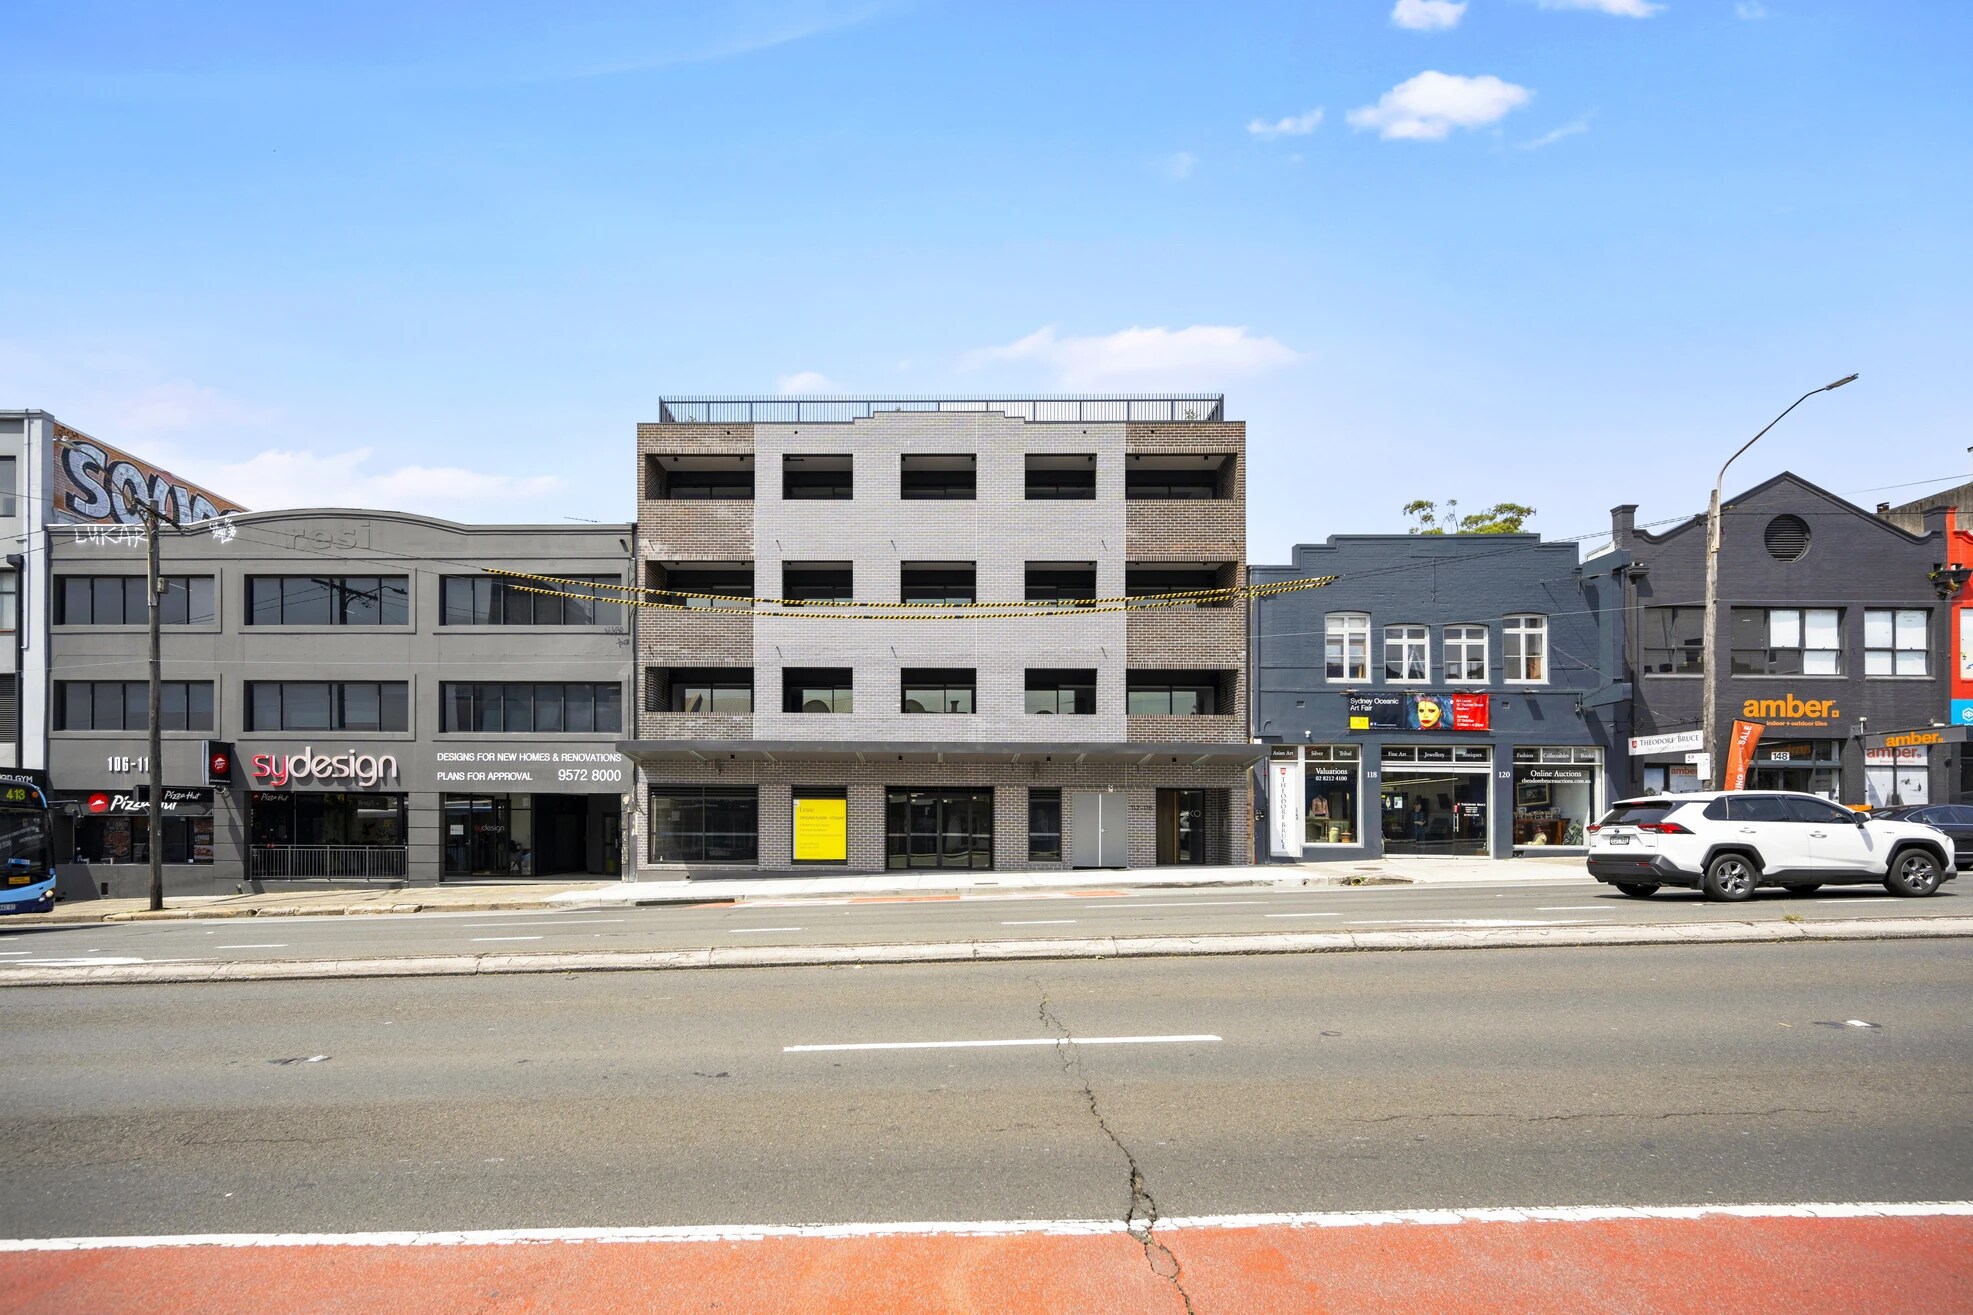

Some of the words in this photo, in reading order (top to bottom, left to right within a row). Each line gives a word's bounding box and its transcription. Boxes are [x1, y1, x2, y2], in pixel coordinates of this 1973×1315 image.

[1350, 697, 1373, 705] Sydney
[1374, 697, 1400, 705] Oceanic
[1738, 725, 1752, 745] SALE
[437, 753, 475, 761] DESIGNS
[477, 753, 496, 761] FOR
[497, 753, 517, 761] NEW
[519, 753, 551, 761] HOMES
[553, 753, 560, 762] &
[561, 753, 621, 762] RENOVATIONS
[252, 746, 397, 787] sydesign
[15, 775, 33, 783] GYM
[437, 772, 465, 781] PLANS
[467, 772, 486, 780] FOR
[487, 772, 533, 780] APPROVAL
[558, 769, 588, 781] 9572
[591, 769, 622, 781] 8000
[6, 788, 26, 800] 413
[164, 790, 186, 800] Pizza
